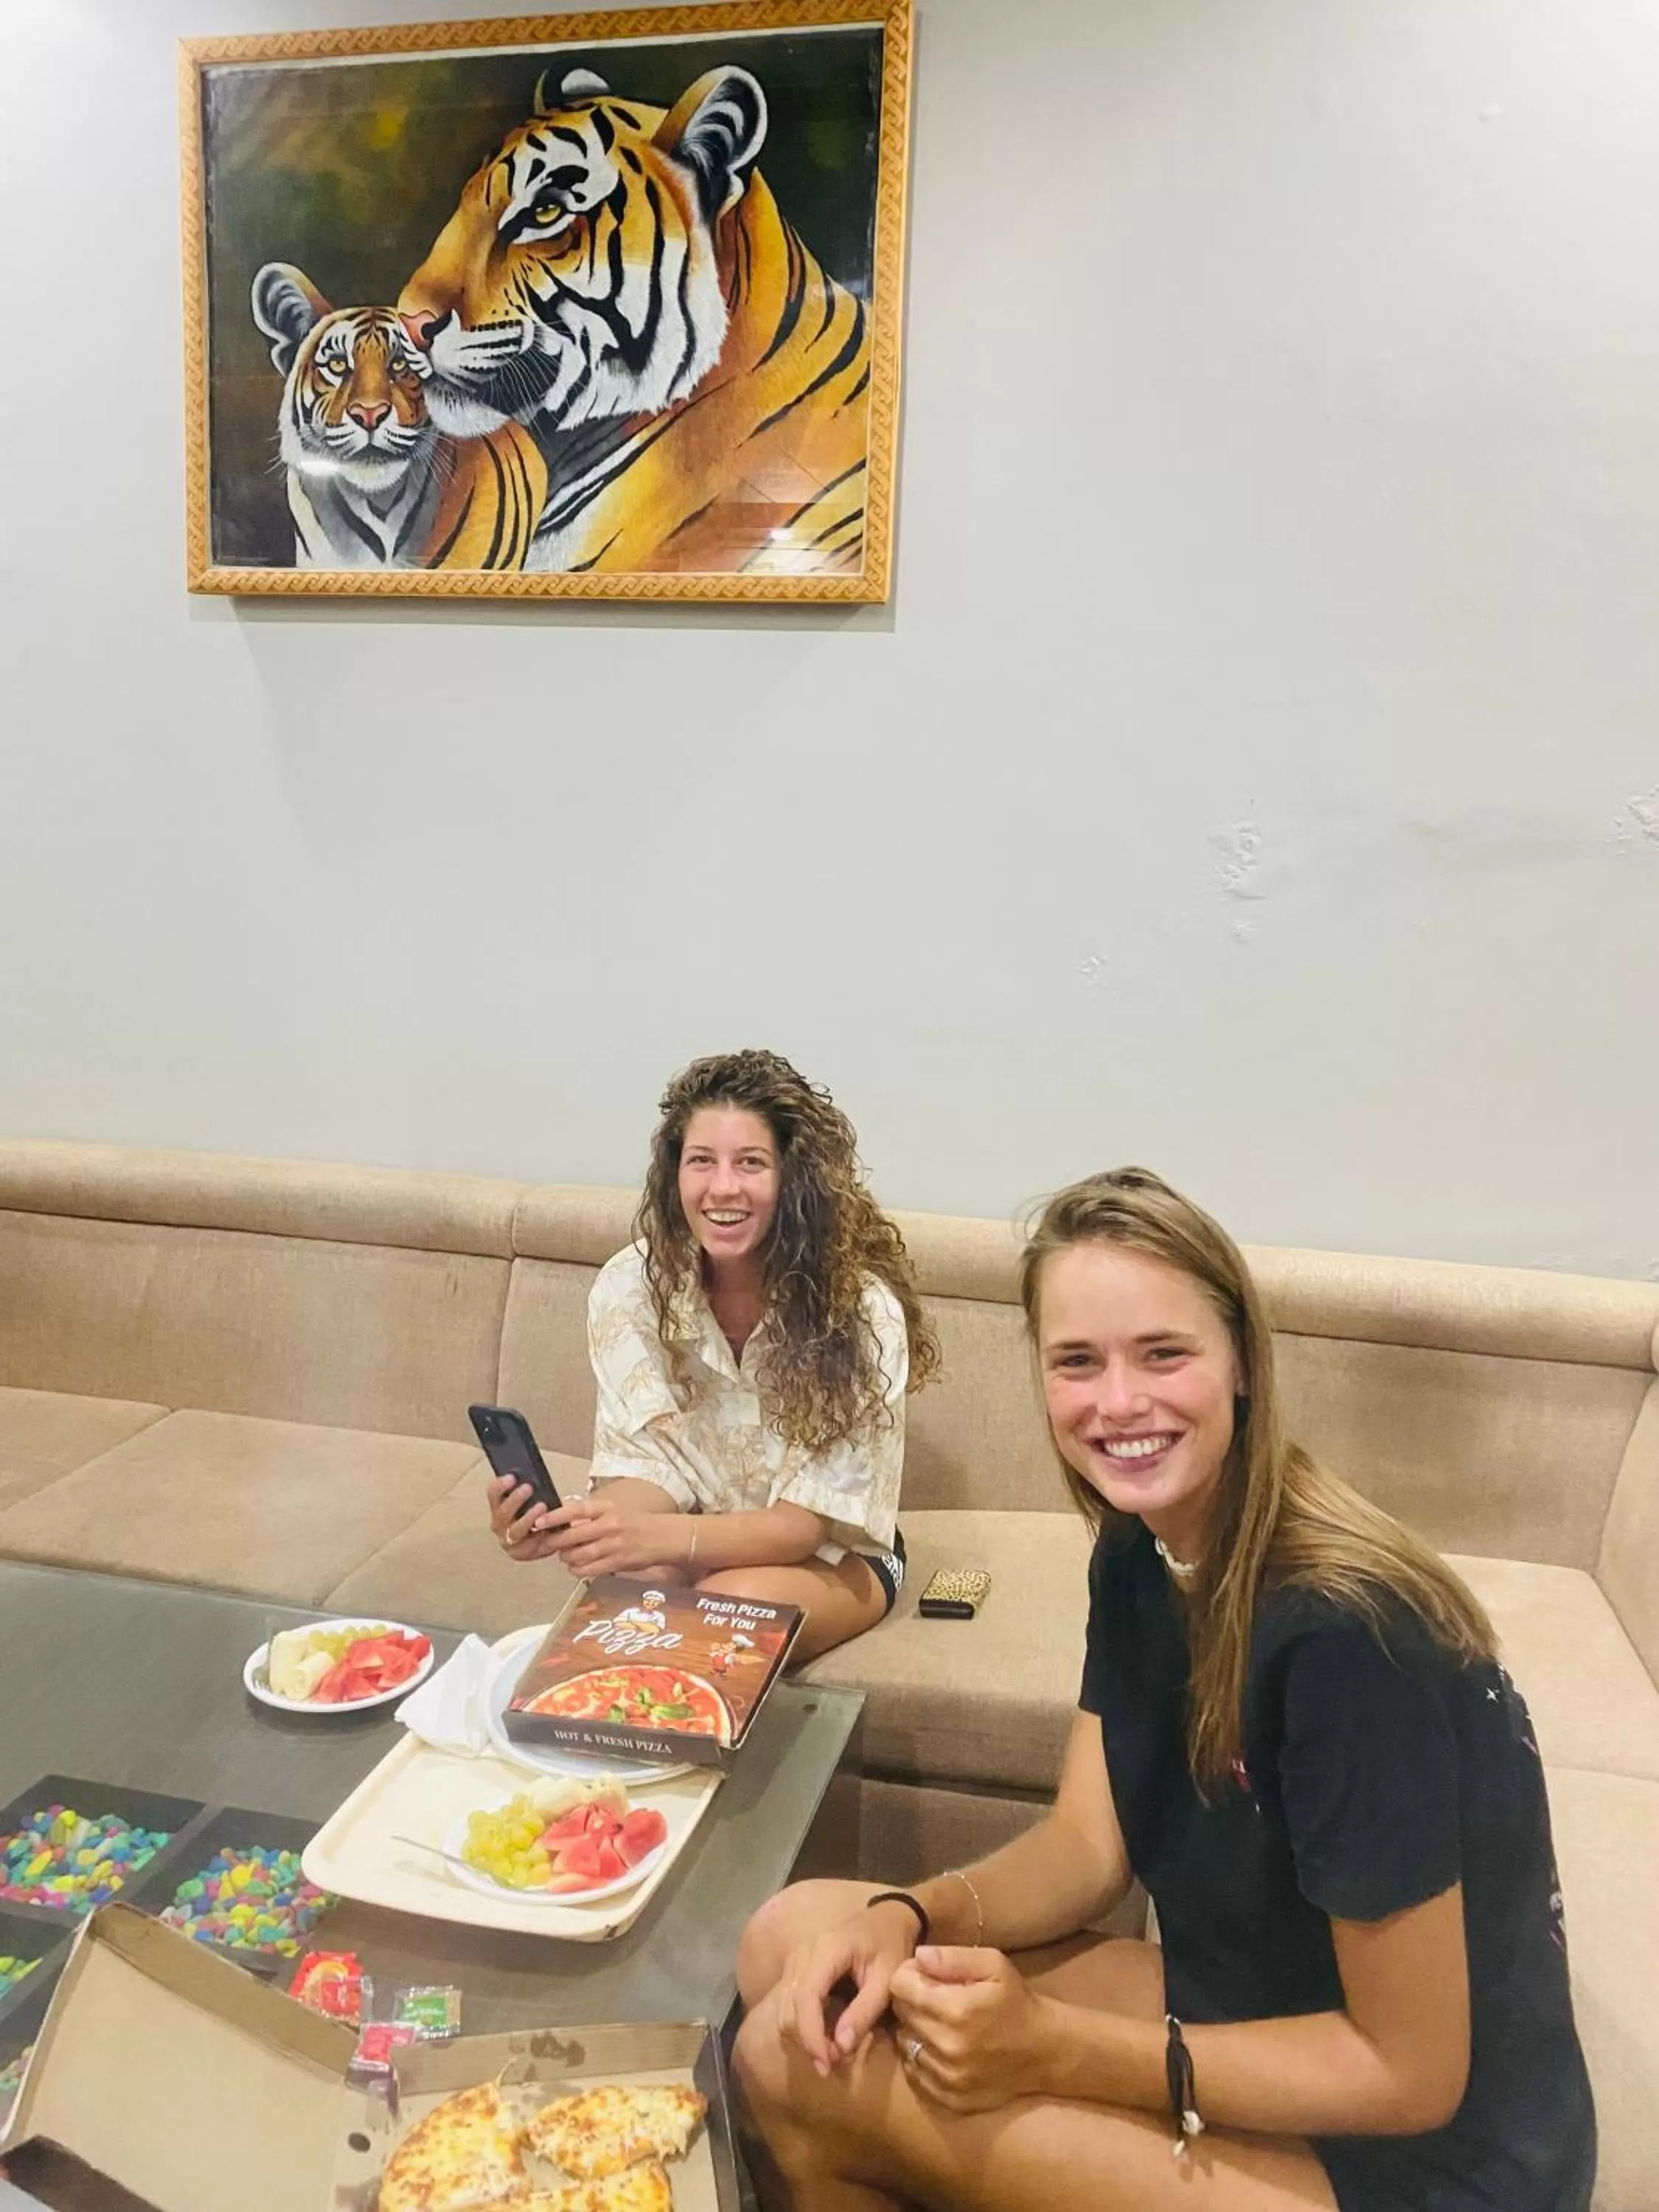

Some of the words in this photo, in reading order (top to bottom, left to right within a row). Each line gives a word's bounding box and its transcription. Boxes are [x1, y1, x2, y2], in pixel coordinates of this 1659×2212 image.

[696, 1598, 737, 1613] Fresh
[703, 1613, 728, 1627] For
[730, 1617, 756, 1630] You
[572, 1620, 684, 1655] Pizza
[554, 1730, 579, 1741] HOT
[583, 1733, 593, 1742] &
[594, 1733, 633, 1749] FRESH
[636, 1739, 672, 1753] PIZZA
